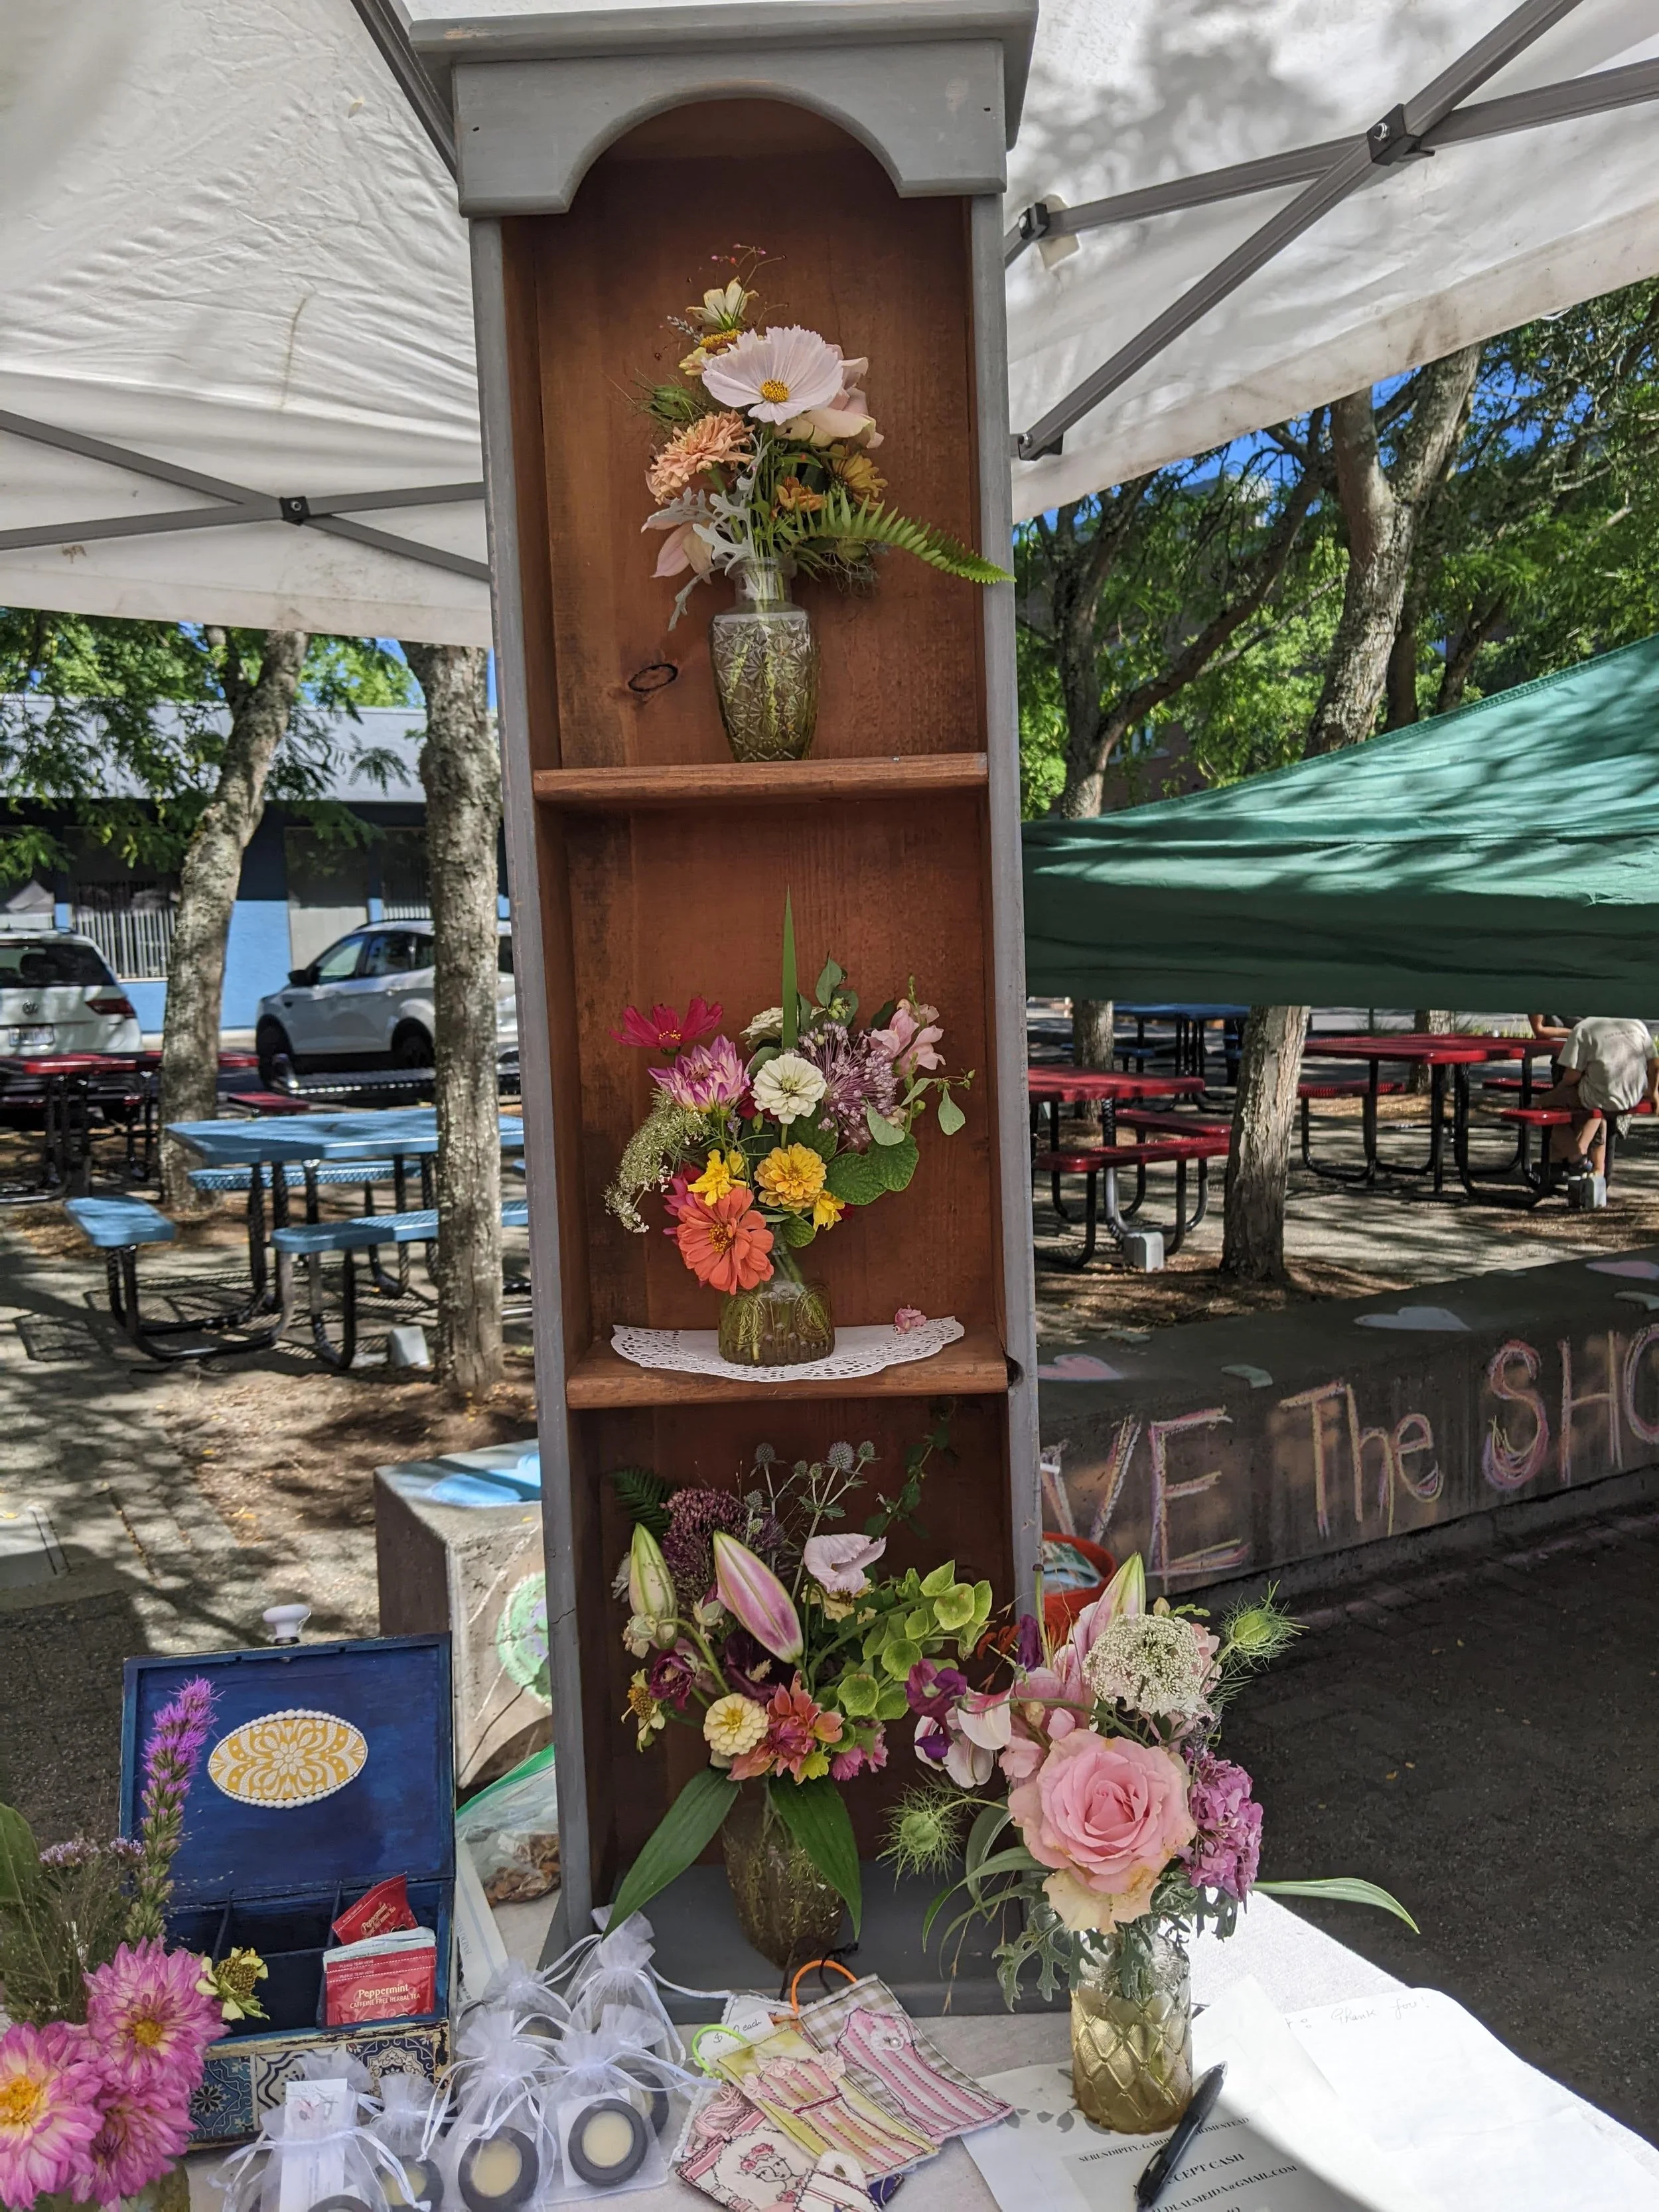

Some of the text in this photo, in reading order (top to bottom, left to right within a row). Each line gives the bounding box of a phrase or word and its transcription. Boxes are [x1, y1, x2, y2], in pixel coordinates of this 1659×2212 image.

[1278, 1381, 1444, 1537] The
[358, 1984, 409, 1999] Peppermint
[350, 2000, 374, 2009] CAFFEINE
[742, 2019, 762, 2031] each
[1168, 2153, 1245, 2184] CCEPT CASH
